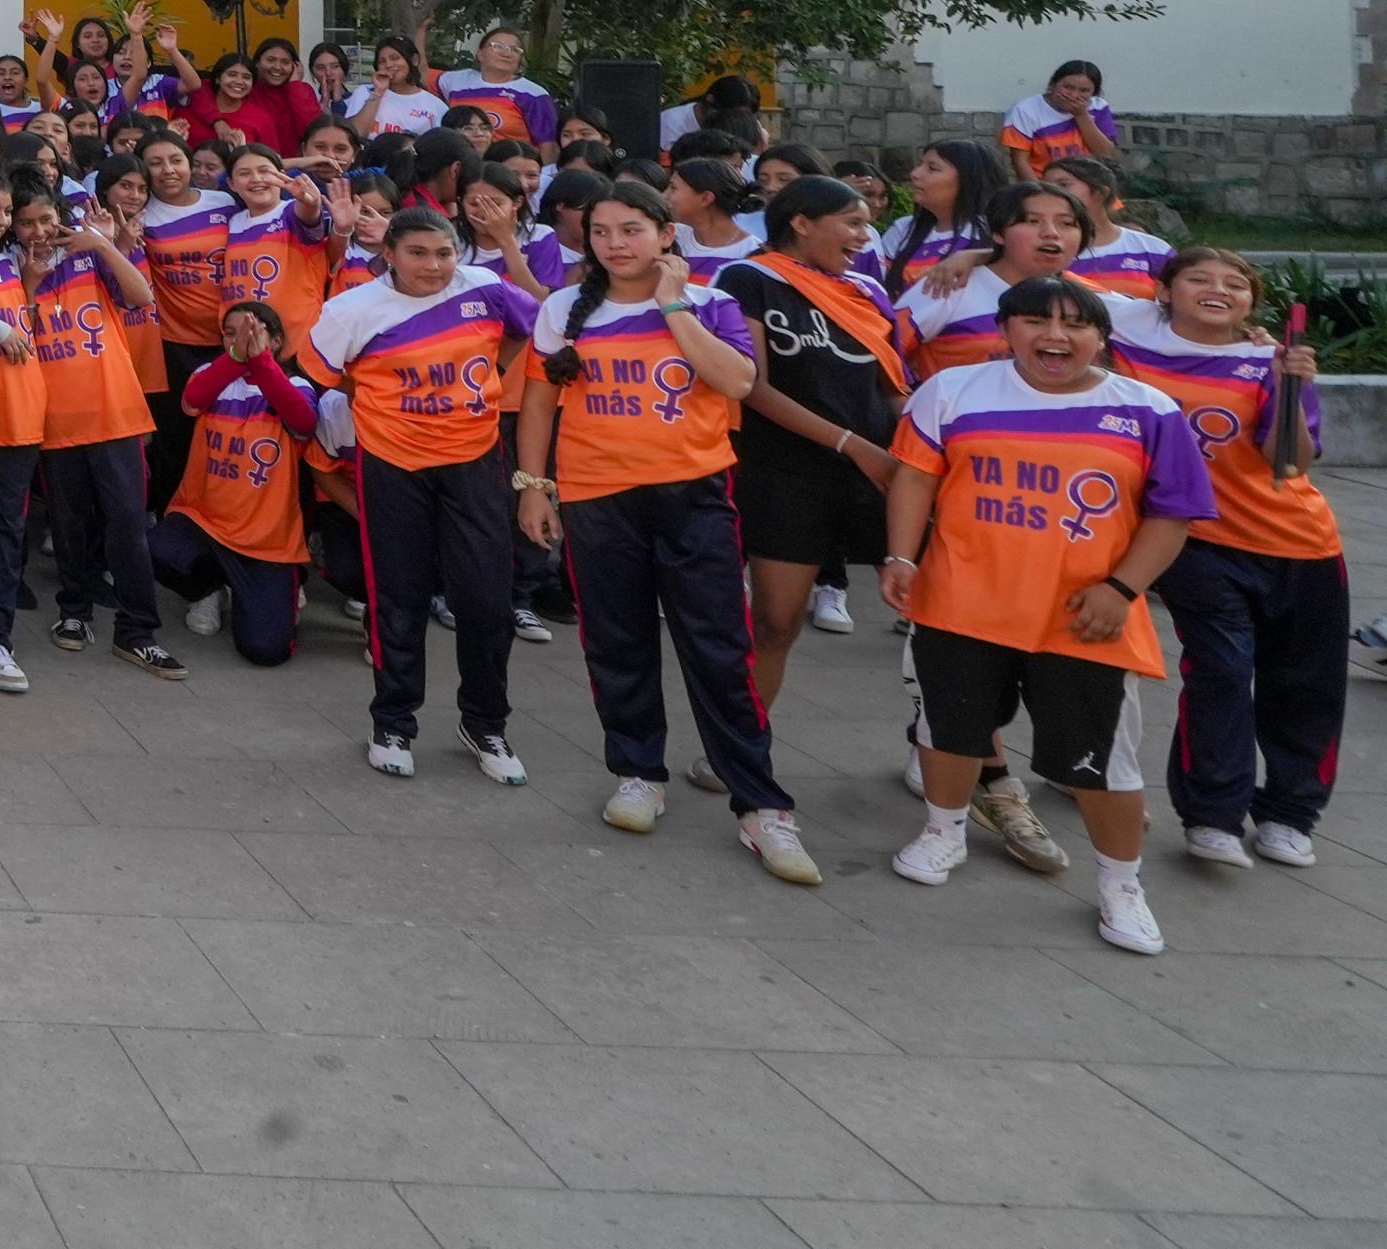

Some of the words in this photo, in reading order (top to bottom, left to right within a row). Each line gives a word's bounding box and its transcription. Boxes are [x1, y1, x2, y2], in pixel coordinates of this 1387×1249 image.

[165, 268, 201, 285] más
[231, 260, 248, 276] NO
[36, 314, 46, 337] A
[49, 311, 73, 333] NO
[38, 336, 76, 362] más
[393, 368, 422, 388] YA
[430, 362, 456, 386] NO
[613, 358, 646, 383] NO
[400, 392, 454, 416] más
[586, 391, 642, 417] más
[205, 429, 224, 450] YA
[970, 455, 1002, 485] YA
[1017, 460, 1060, 494] NO
[975, 495, 1048, 530] más
